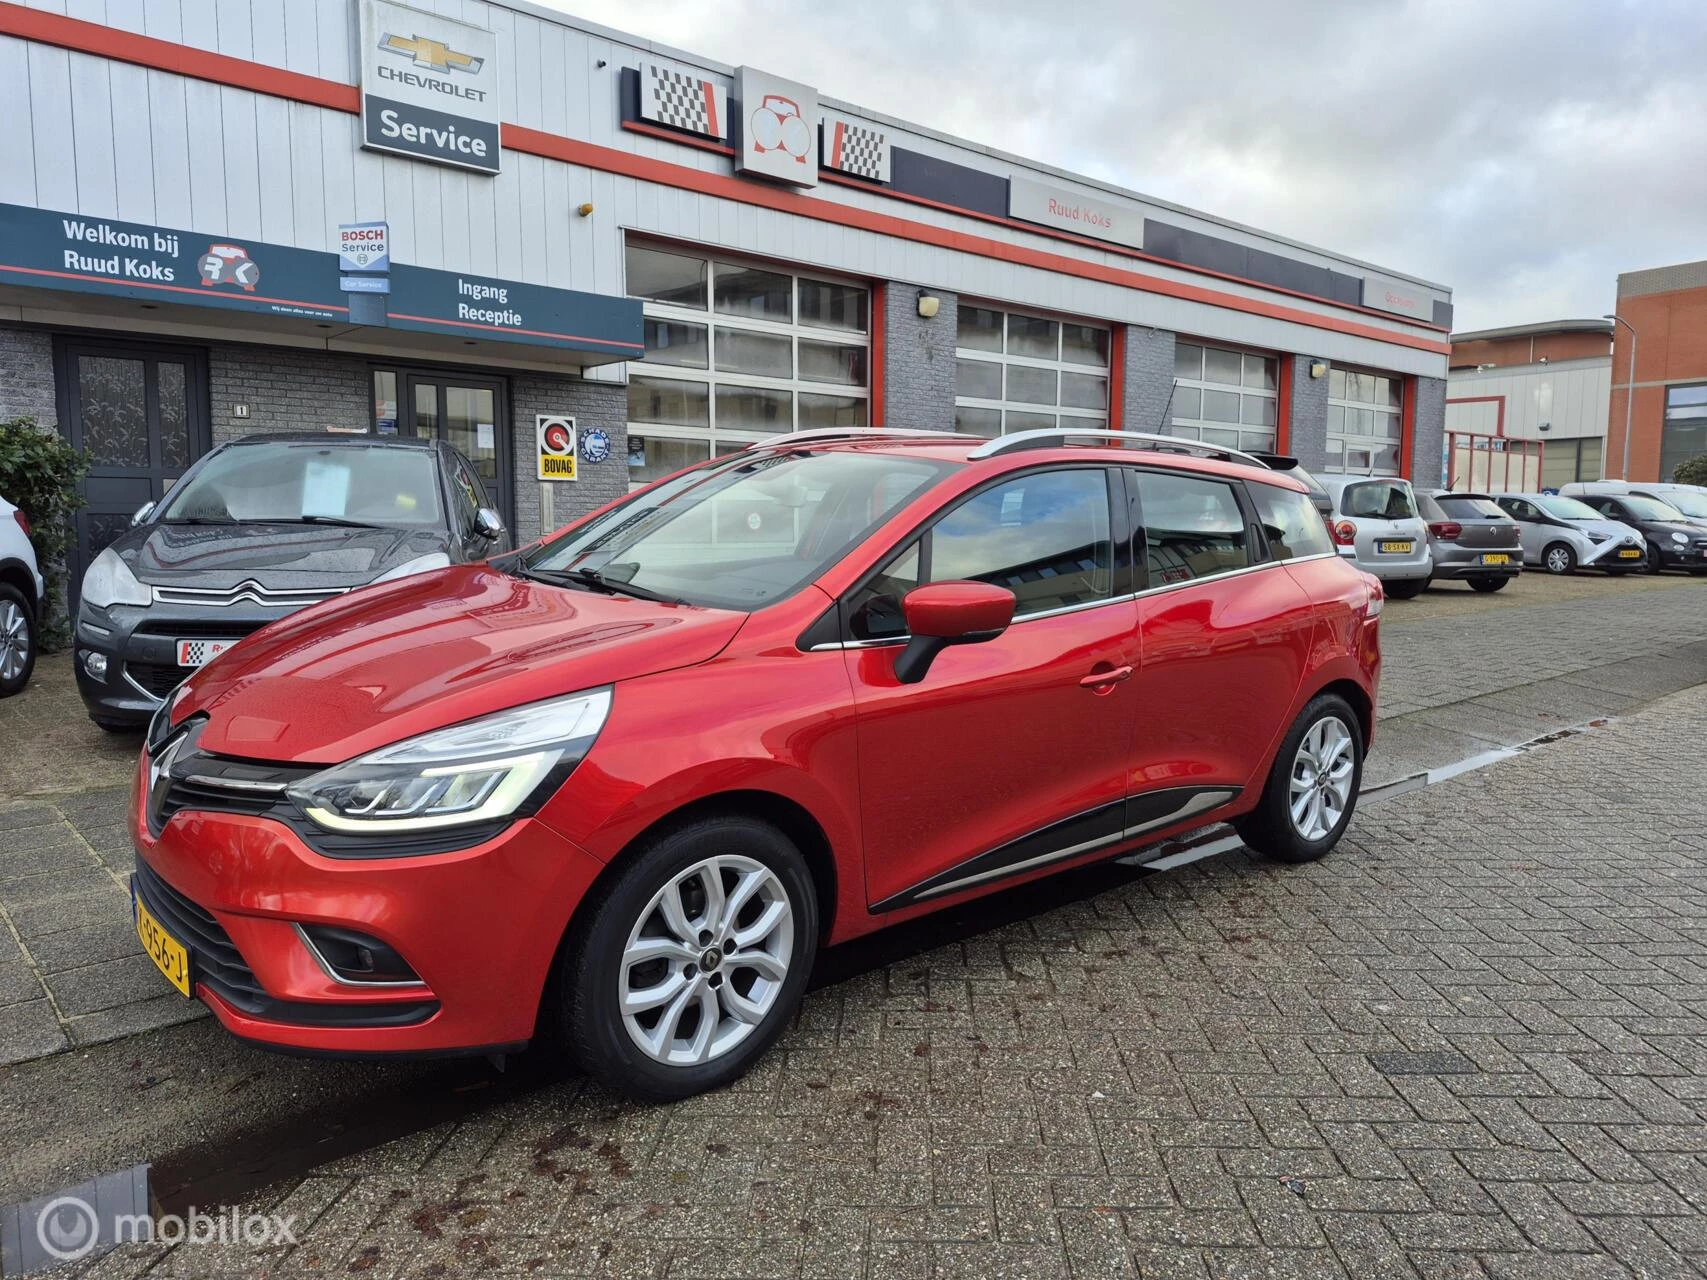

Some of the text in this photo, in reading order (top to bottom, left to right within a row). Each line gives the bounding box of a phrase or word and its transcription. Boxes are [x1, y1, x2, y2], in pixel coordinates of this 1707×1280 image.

[377, 66, 487, 103] CHEVROLET
[380, 109, 487, 157] Service
[1048, 198, 1112, 228] Ruud Koks
[63, 219, 179, 258] Welkom bij
[341, 230, 384, 241] BOSCH
[342, 243, 384, 252] Service
[63, 250, 175, 282] Ruud Koks
[458, 278, 508, 303] Ingang
[458, 303, 522, 327] Receptie
[544, 458, 572, 474] BOVAG
